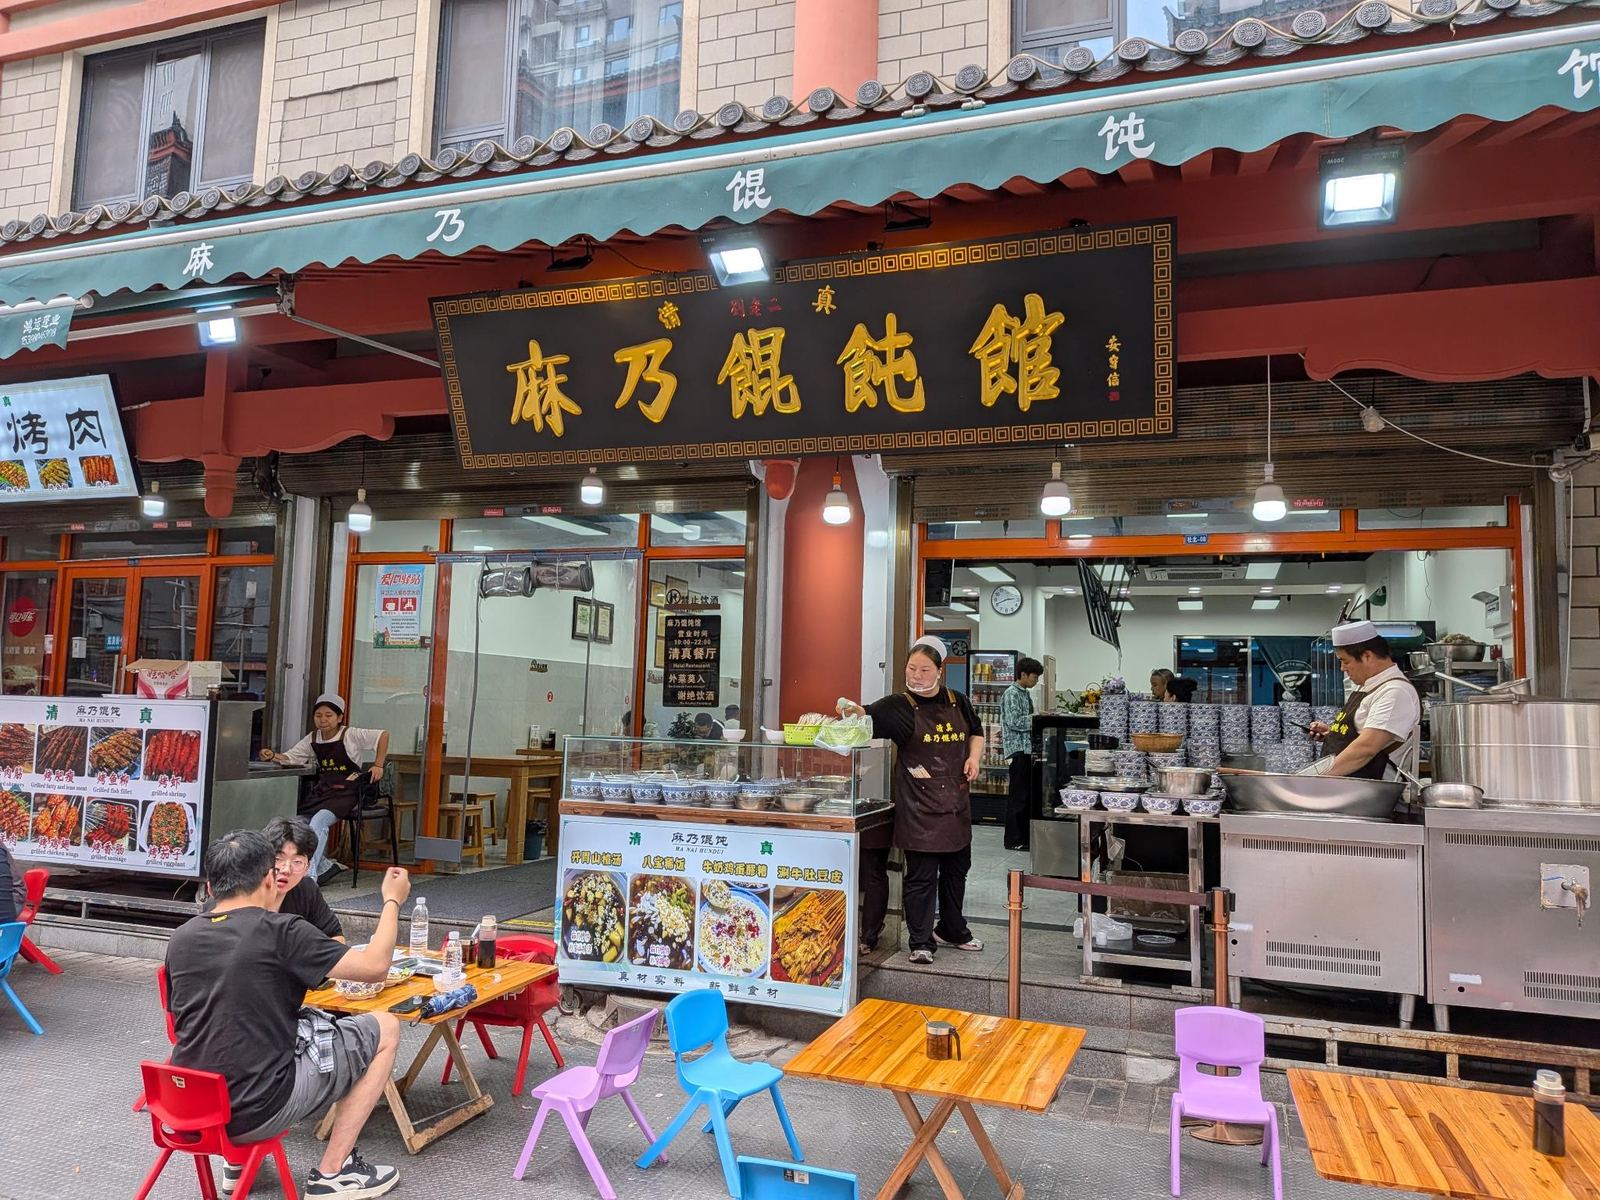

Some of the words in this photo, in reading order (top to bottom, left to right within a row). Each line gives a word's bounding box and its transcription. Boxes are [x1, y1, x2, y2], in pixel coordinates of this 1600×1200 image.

[182, 242, 214, 277] 麻
[426, 208, 465, 242] 乃
[726, 168, 772, 212] 馄
[1098, 111, 1155, 160] 饨
[658, 300, 681, 330] 清
[811, 285, 837, 315] 真
[6, 407, 107, 455] 烤肉
[668, 648, 716, 660] 清真餐厅
[46, 705, 58, 720] 清
[140, 707, 152, 723] 真
[629, 832, 641, 845] 清
[672, 832, 728, 847] 麻乃馄饨
[760, 841, 773, 855] 真
